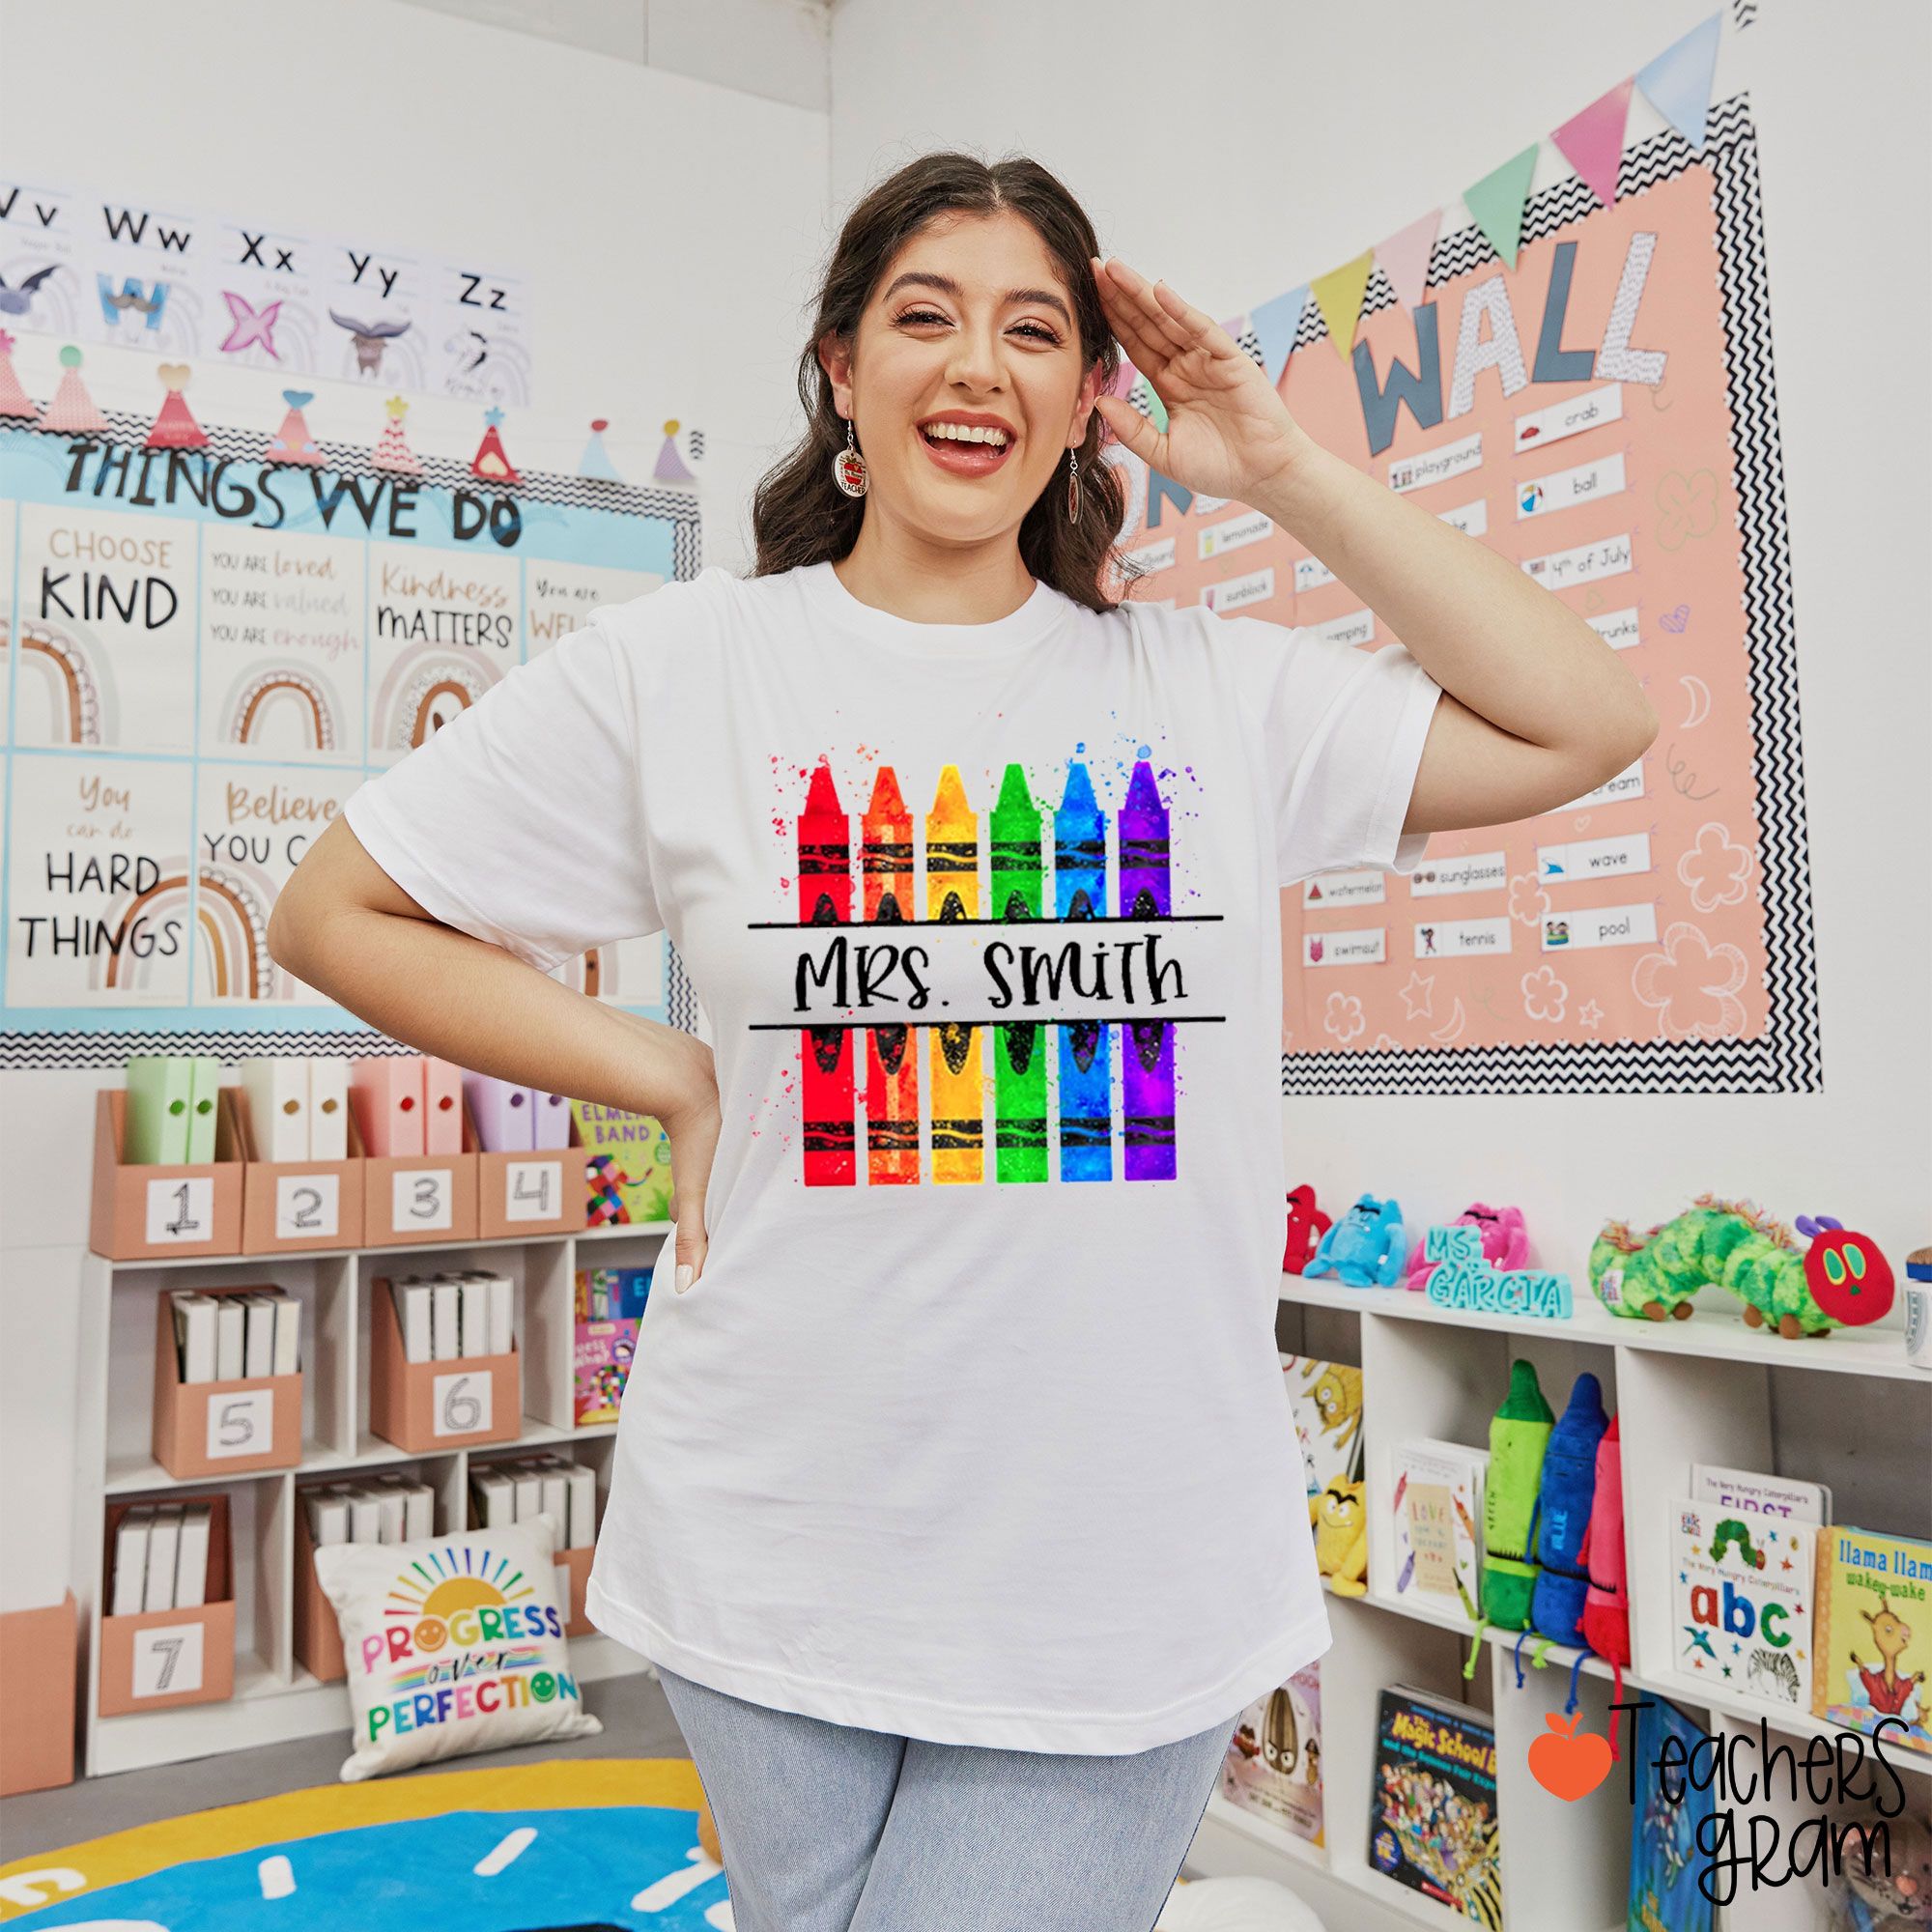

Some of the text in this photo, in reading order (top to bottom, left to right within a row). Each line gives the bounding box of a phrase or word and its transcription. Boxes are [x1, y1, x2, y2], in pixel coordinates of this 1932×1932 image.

[1352, 232, 1669, 456] WALL
[1565, 402, 1599, 426] crab
[1414, 439, 1483, 480] playground
[64, 444, 522, 547] THINGS WE DO
[1573, 472, 1598, 494] ball
[49, 528, 173, 569] CHOOSE
[211, 550, 335, 581] YOU ARE loved
[1577, 553, 1594, 573] of
[1601, 546, 1631, 567] July
[41, 566, 177, 629] KIND
[211, 588, 239, 606] YOU
[243, 591, 267, 609] ARE
[381, 562, 510, 609] Kindness
[210, 624, 239, 641] YOU
[243, 627, 266, 644] ARE
[78, 776, 131, 813] You
[225, 781, 339, 825] Believe
[203, 832, 270, 866] YOU
[1589, 852, 1628, 868] wave
[45, 851, 160, 896] HARD
[1440, 864, 1506, 886] sunglasses
[18, 915, 183, 958] THINGS
[1599, 916, 1631, 942] pool
[595, 1125, 649, 1144] BAND
[165, 1181, 200, 1235] 1
[292, 1186, 324, 1228] 2
[410, 1178, 441, 1218] 3
[513, 1170, 550, 1211] 4
[1429, 1229, 1471, 1261] MS
[1430, 1261, 1562, 1317] GARCIA
[219, 1401, 255, 1446] 5
[443, 1377, 481, 1431] 6
[1412, 1501, 1445, 1522] LOVE
[1839, 1539, 1932, 1582] llama llam
[1690, 1581, 1793, 1648] abc
[362, 1605, 562, 1675] PROGRESS
[151, 1636, 185, 1690] 7
[368, 1671, 579, 1742] PERFECTION
[1392, 1711, 1436, 1749] Magic
[1435, 1727, 1488, 1771] School
